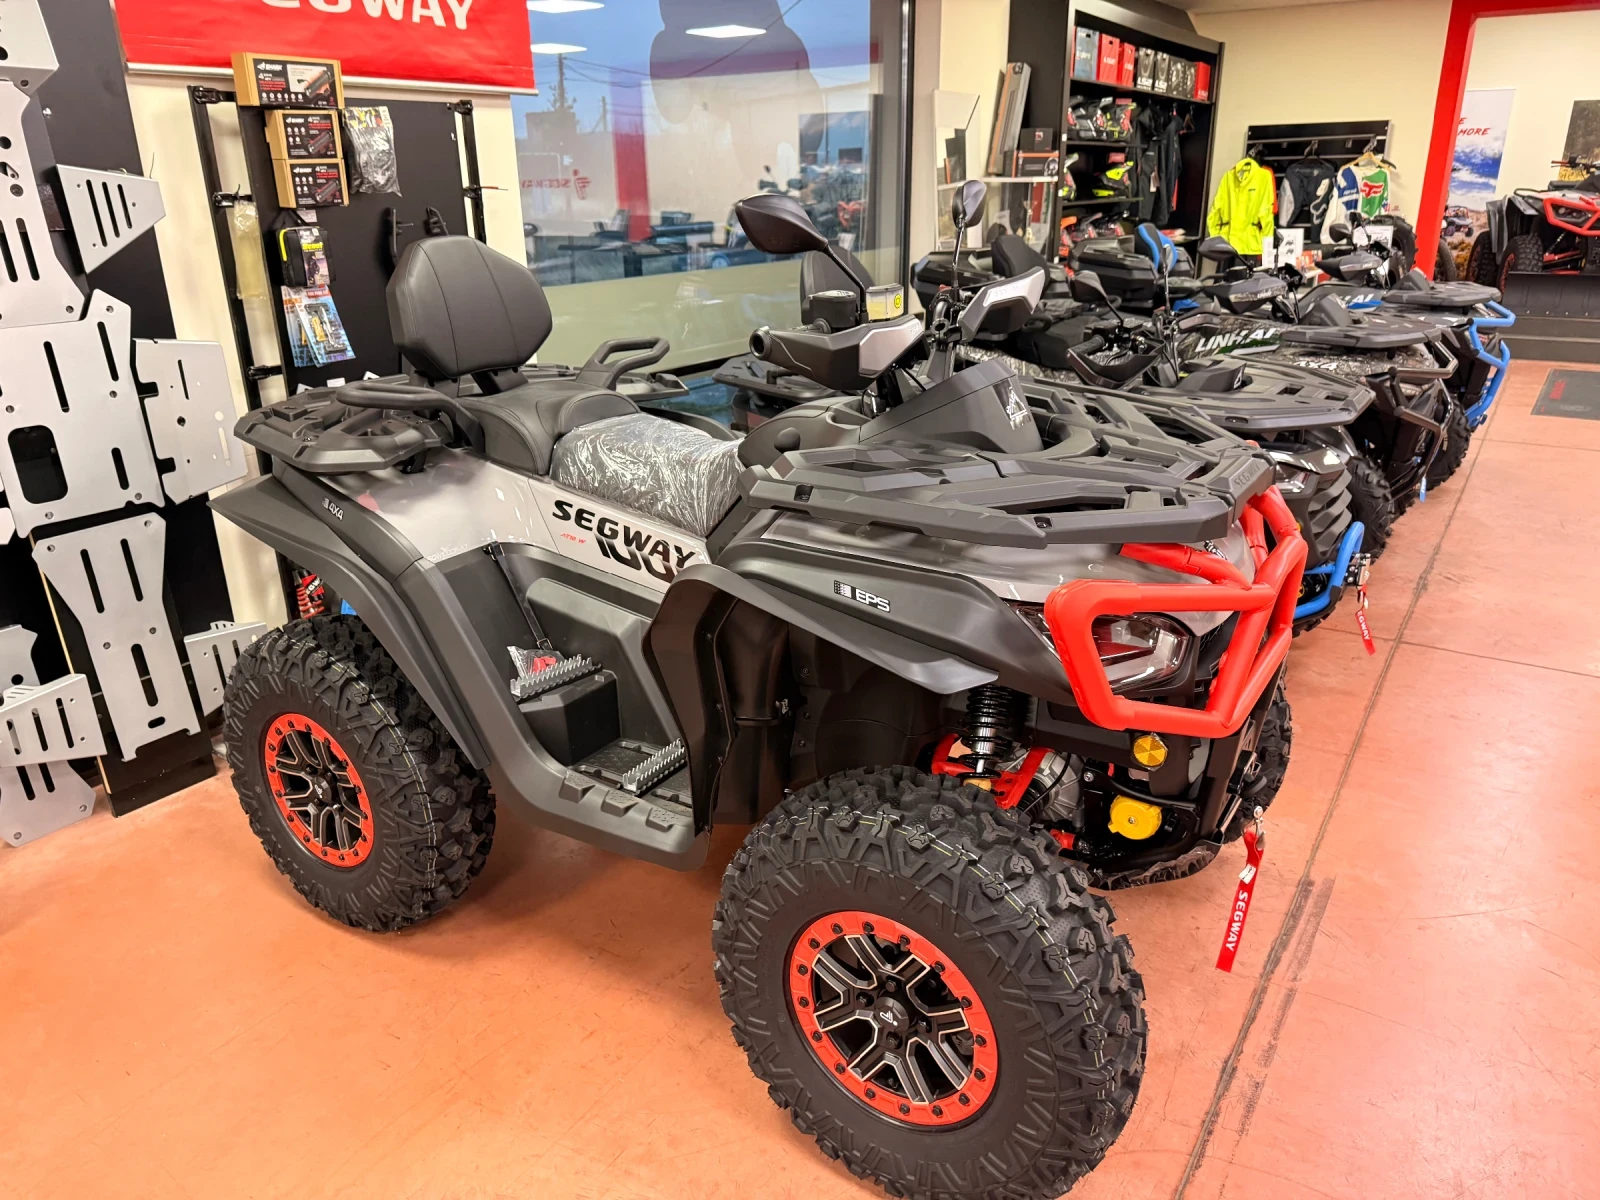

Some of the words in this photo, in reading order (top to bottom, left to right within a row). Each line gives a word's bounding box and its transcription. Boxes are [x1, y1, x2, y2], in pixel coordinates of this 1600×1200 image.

[1137, 77, 1153, 87] LS2
[1155, 80, 1168, 90] LS2
[552, 499, 697, 570] SEGWAY
[855, 588, 890, 612] EPS
[1225, 890, 1249, 952] SEGWAY
